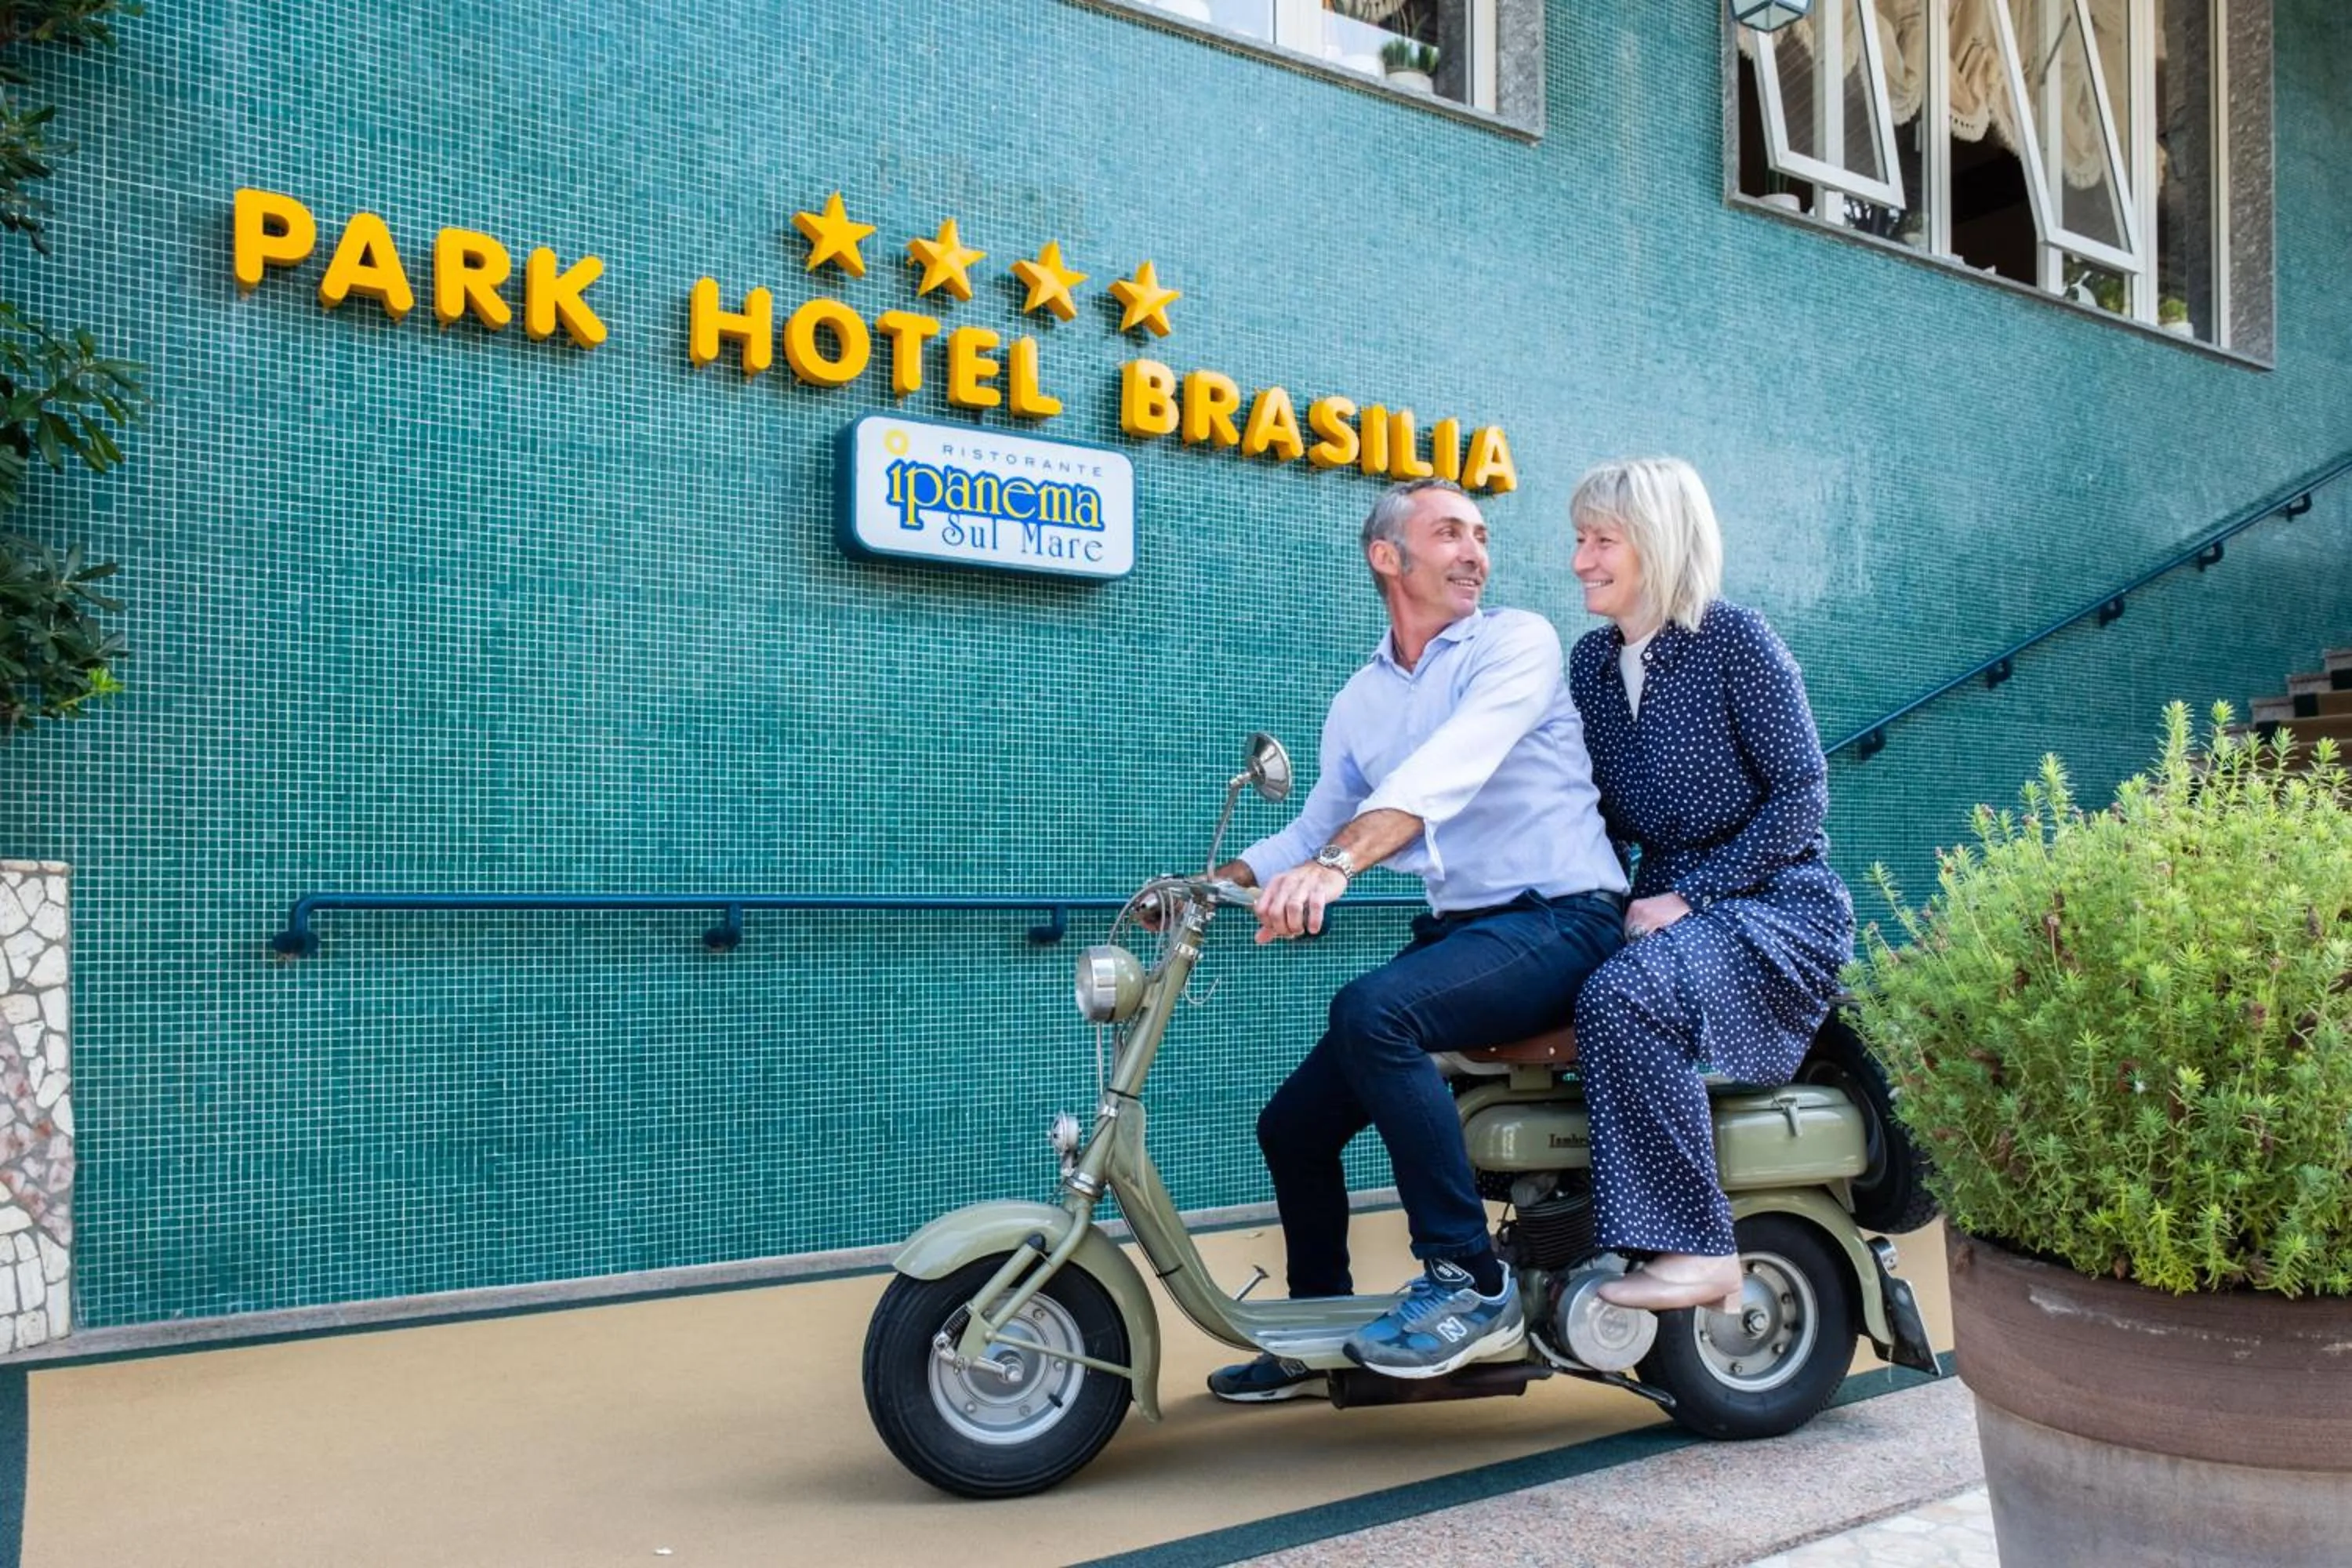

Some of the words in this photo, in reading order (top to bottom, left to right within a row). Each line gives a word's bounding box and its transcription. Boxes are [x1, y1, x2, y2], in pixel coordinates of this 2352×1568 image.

[234, 187, 608, 350] PARK
[689, 275, 1063, 418] HOTEL
[1120, 358, 1518, 493] BRASILIA
[942, 444, 1103, 477] RISTORANTE
[941, 514, 998, 550] Sul
[1021, 521, 1104, 562] Mare
[1548, 1133, 1588, 1149] Lambr
